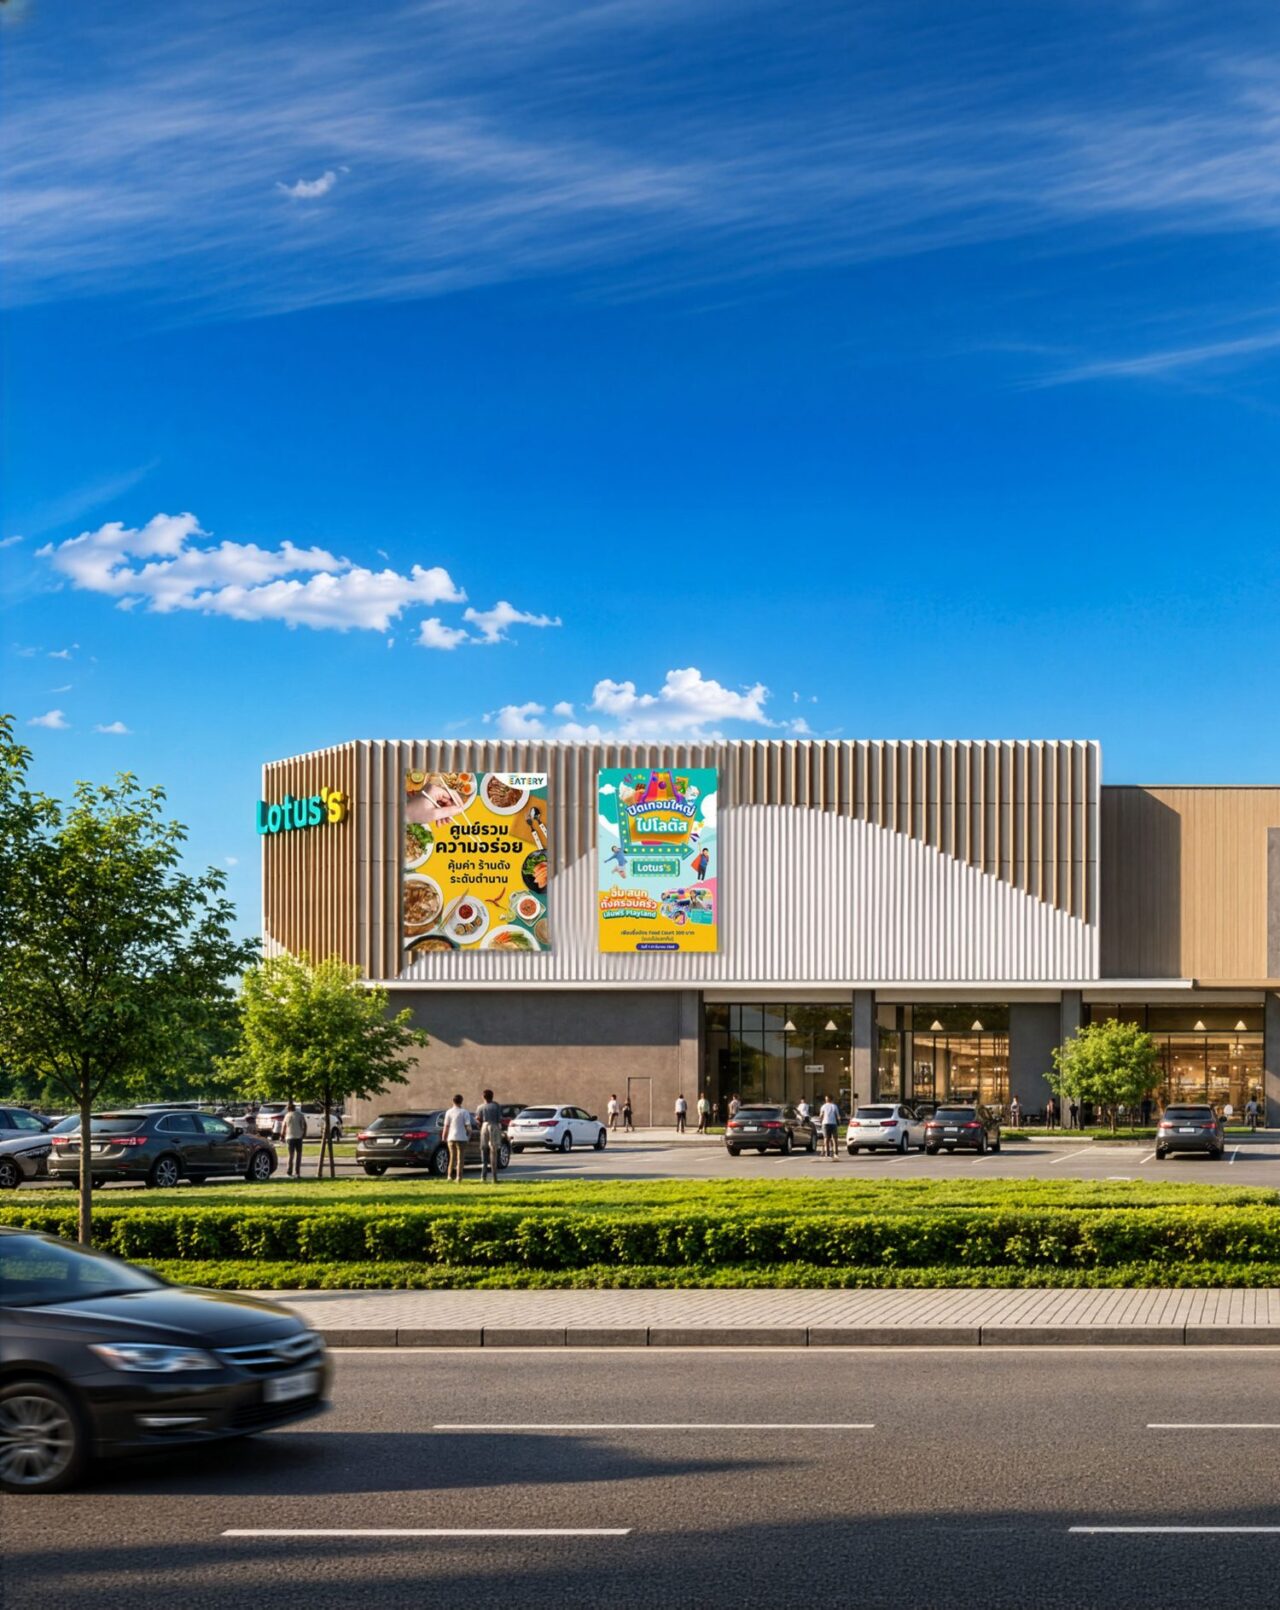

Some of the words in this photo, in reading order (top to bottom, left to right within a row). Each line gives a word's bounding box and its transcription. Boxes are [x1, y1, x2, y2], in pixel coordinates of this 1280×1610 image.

[509, 777, 544, 785] EATERY
[256, 786, 345, 836] Lotus's
[450, 821, 509, 840] ศูนย์รวม
[636, 817, 688, 832] ไปโลตัส
[435, 838, 523, 853] ความอร่อย
[448, 859, 476, 873] คุ้มค่า
[478, 859, 511, 870] ร้านดัง
[637, 863, 672, 872] Lotus's
[450, 874, 509, 884] ระดับตำนาน
